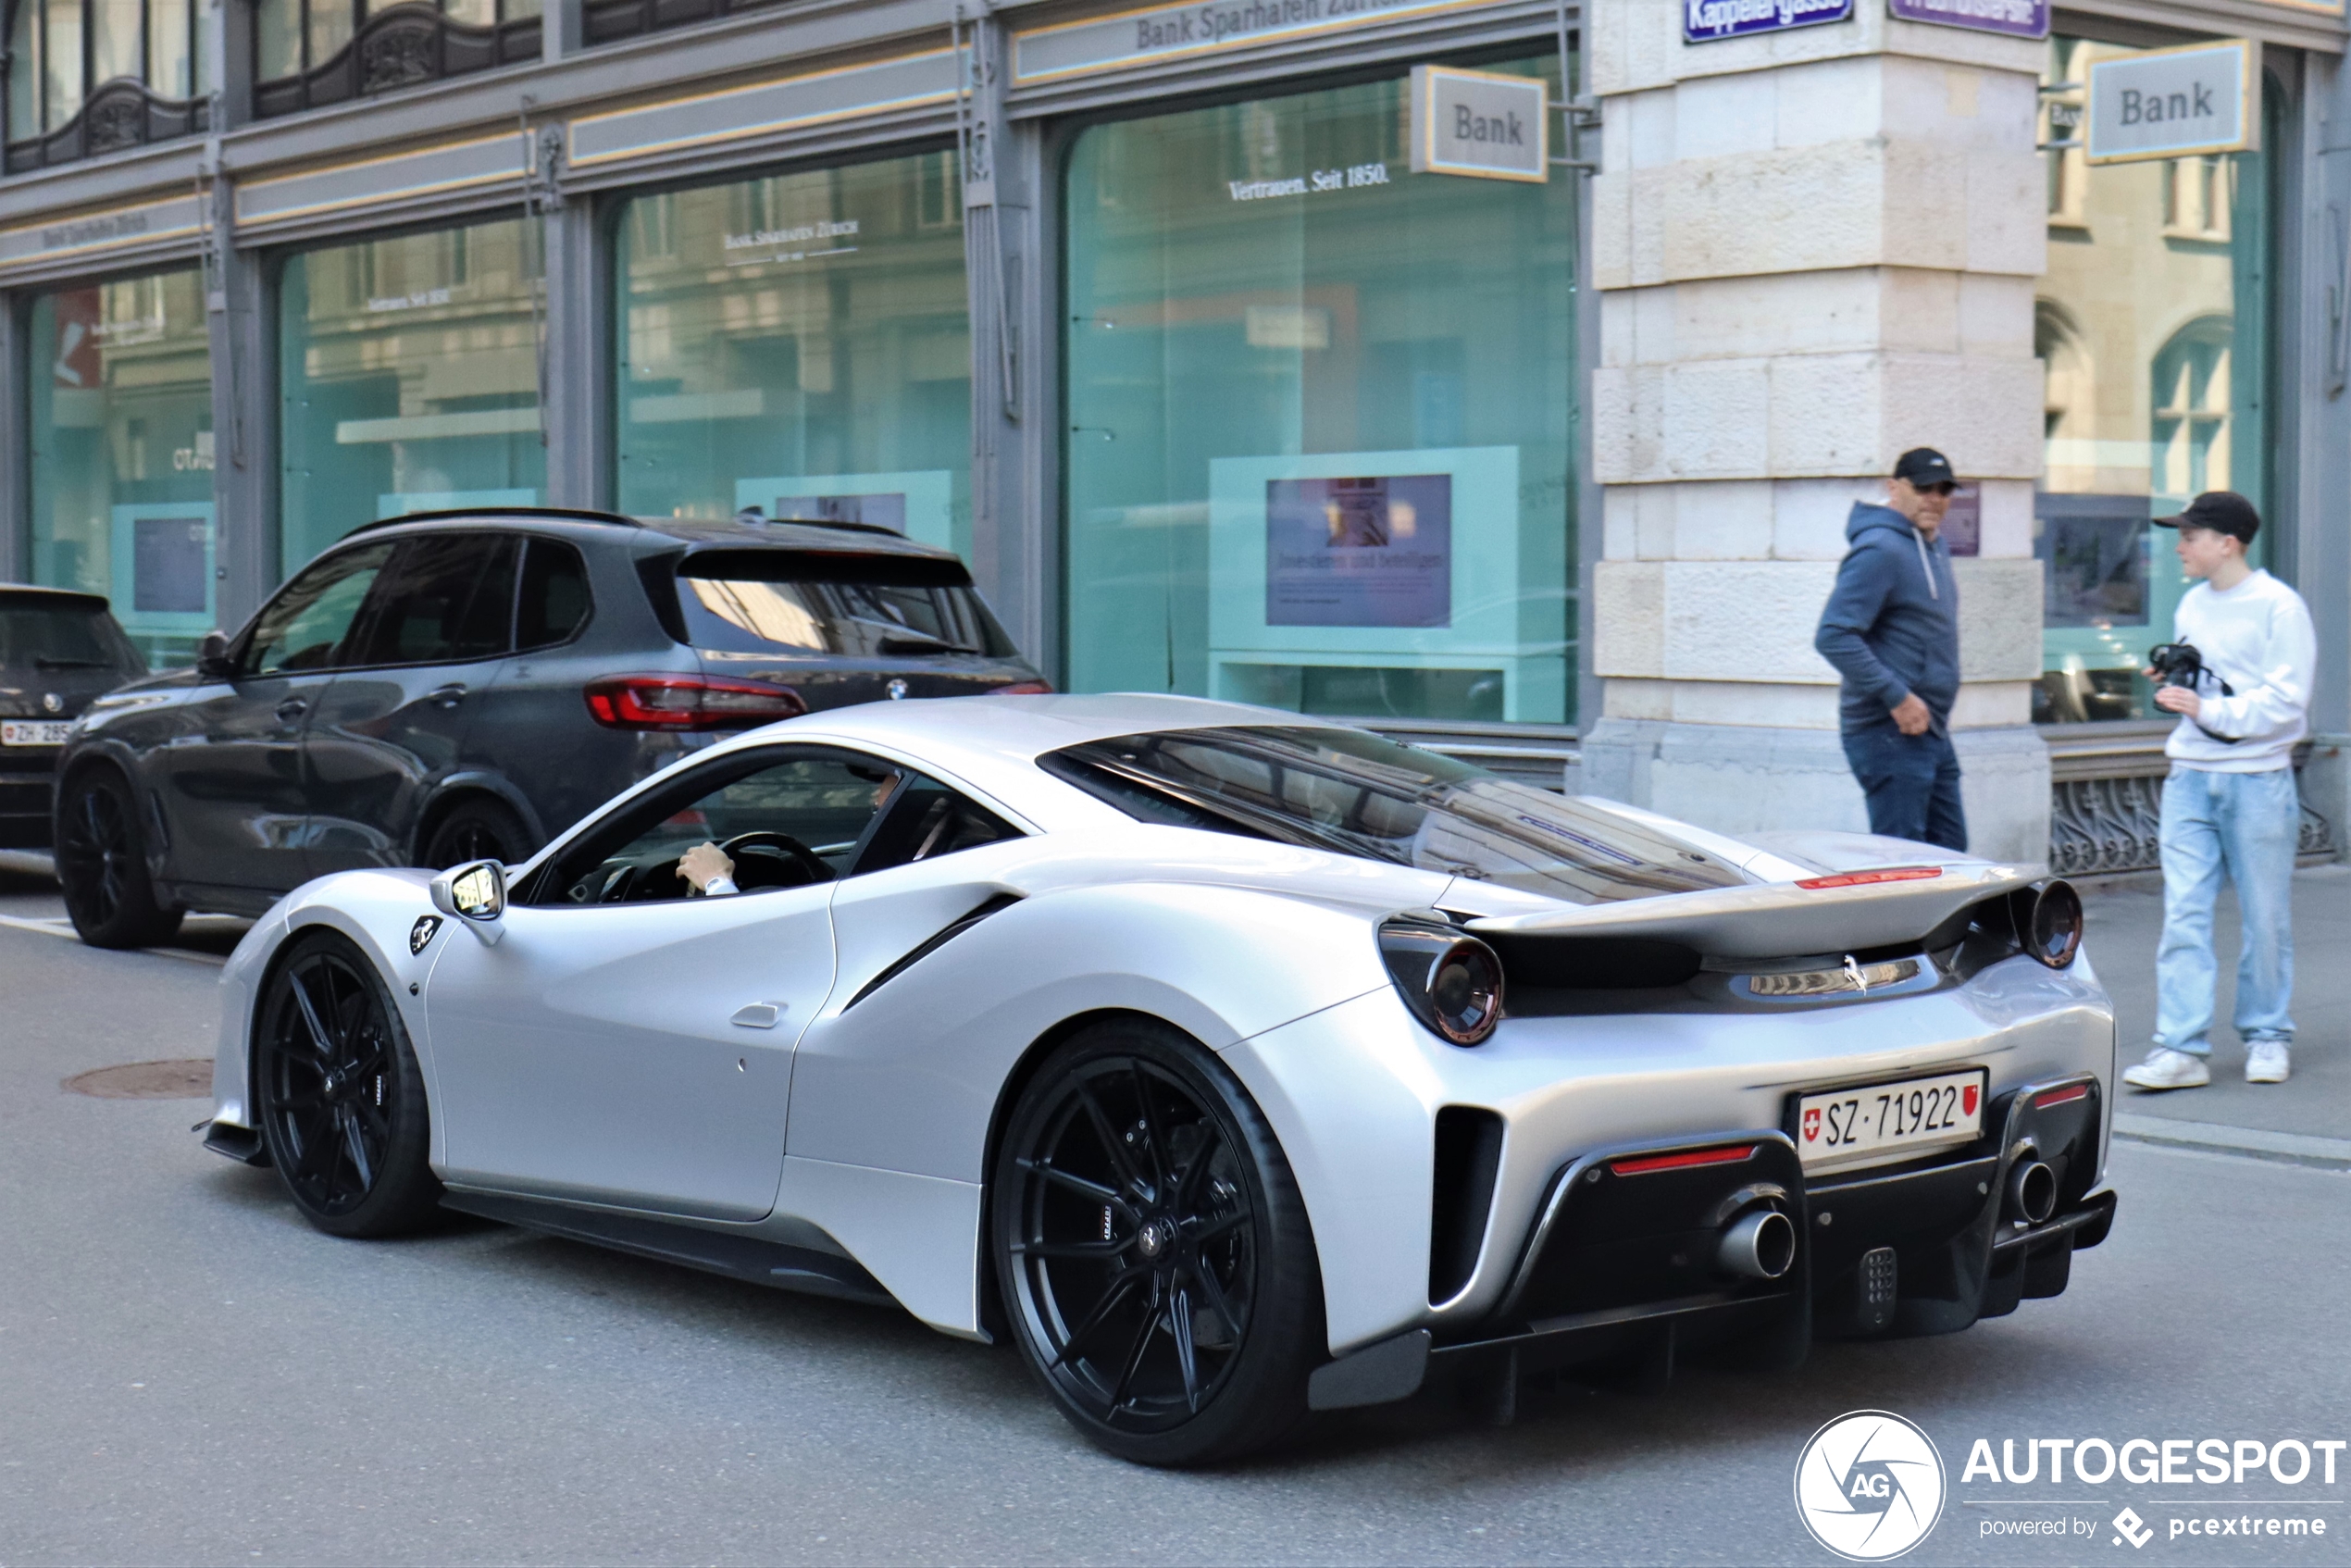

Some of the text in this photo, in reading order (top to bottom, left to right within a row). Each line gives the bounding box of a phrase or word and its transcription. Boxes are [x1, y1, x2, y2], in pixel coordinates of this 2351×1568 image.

[1138, 19, 1193, 49] Bank
[2121, 81, 2214, 126] Bank
[1453, 103, 1524, 145] Bank
[1312, 168, 1343, 192] Seit
